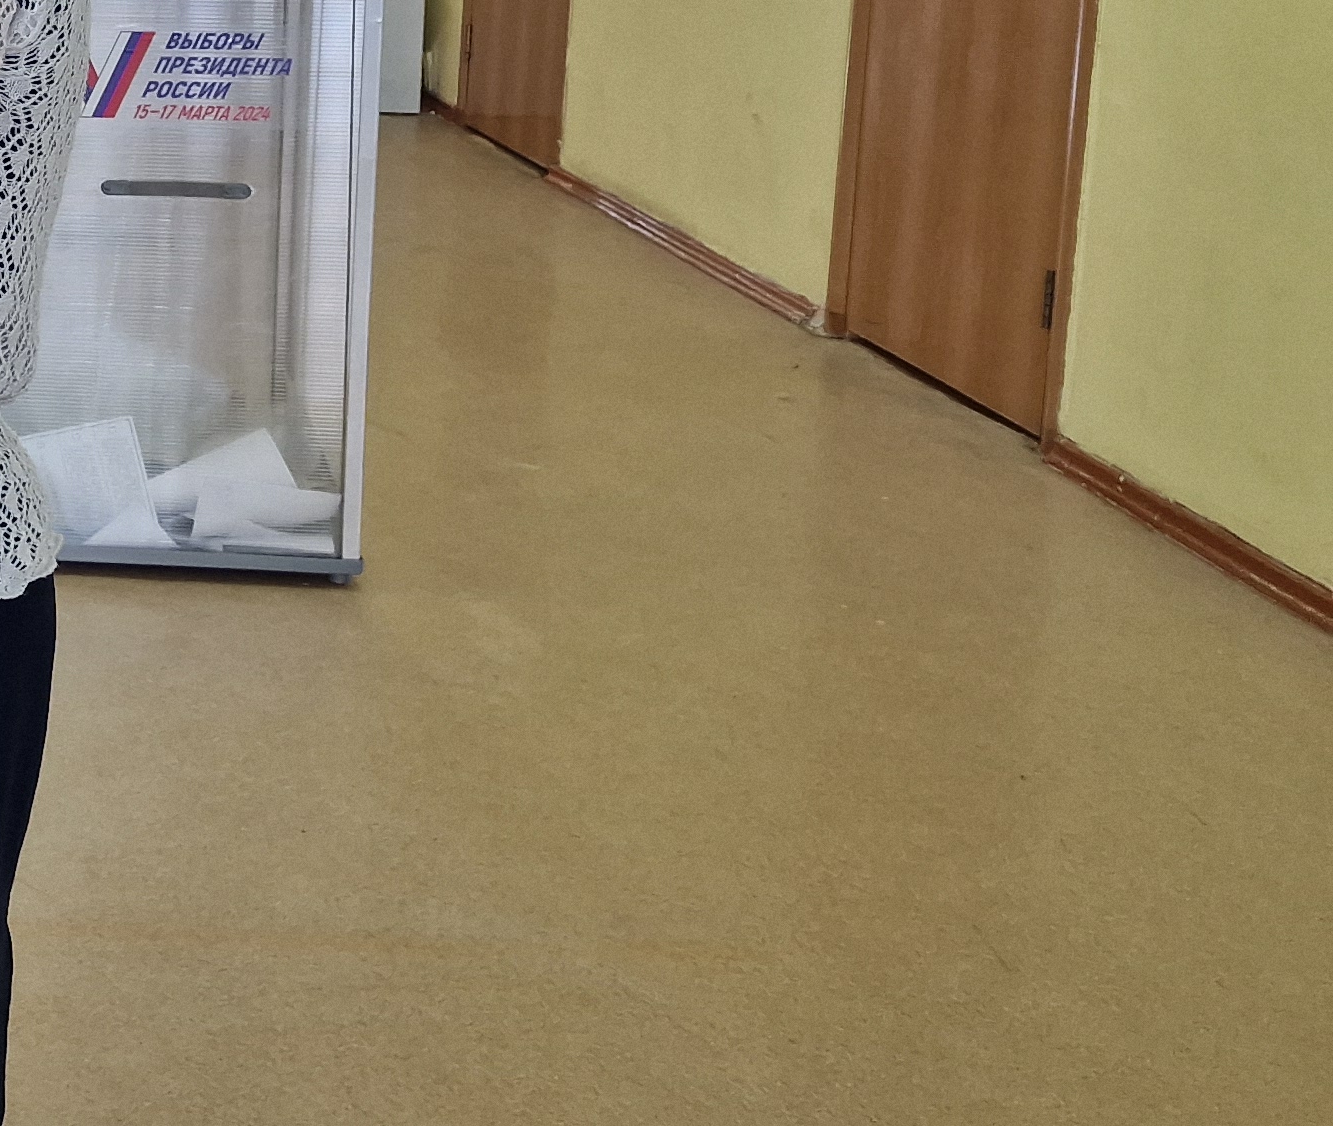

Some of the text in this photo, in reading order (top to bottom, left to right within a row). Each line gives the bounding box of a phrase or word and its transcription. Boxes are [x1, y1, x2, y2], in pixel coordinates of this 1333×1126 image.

[165, 32, 264, 50] ВЫБОРЫ
[153, 57, 293, 77] ПРЕЗИДЕНТА
[142, 80, 232, 99] РОССИИ
[178, 105, 230, 120] МАРТА
[234, 106, 271, 121] 2024
